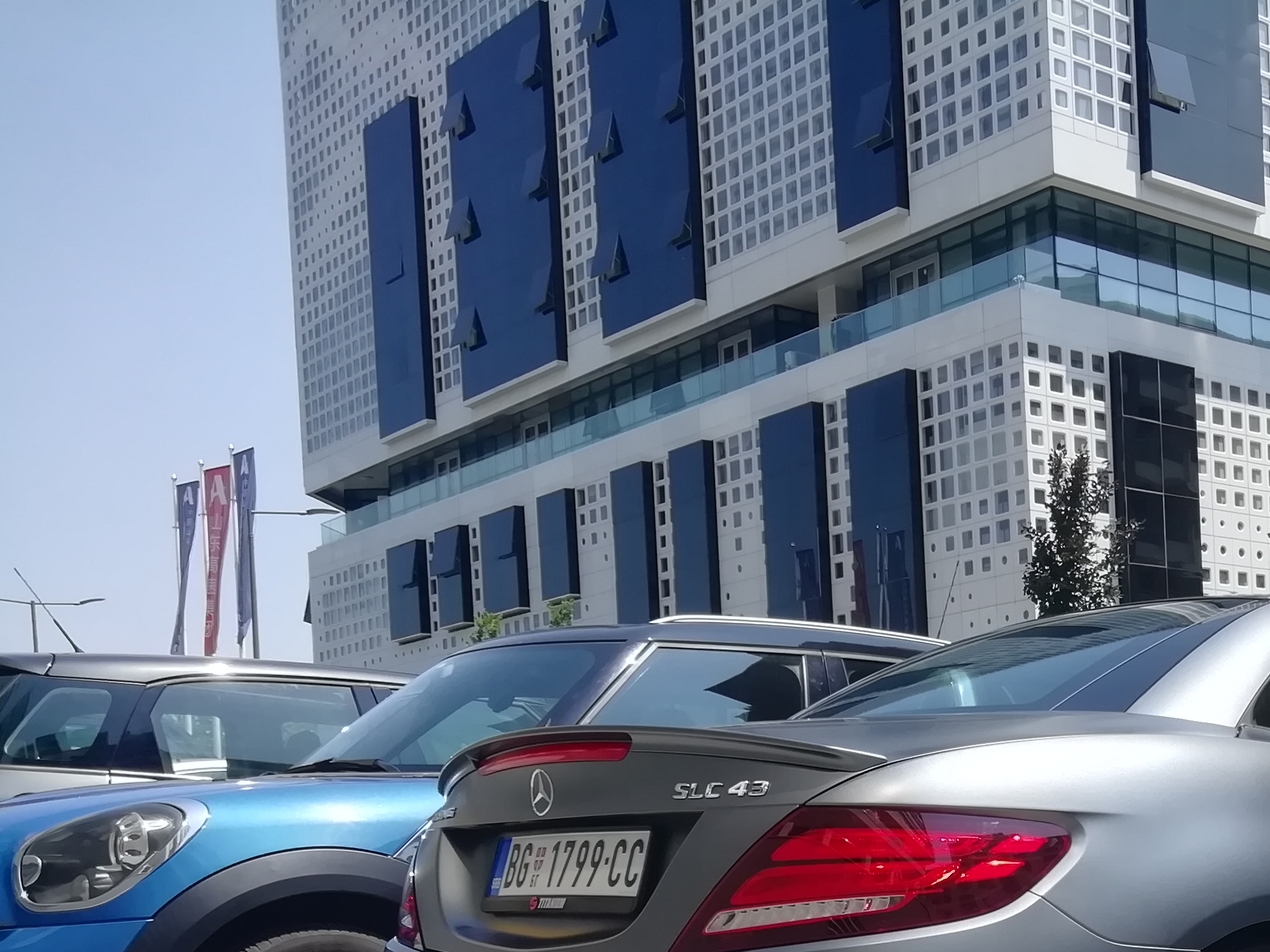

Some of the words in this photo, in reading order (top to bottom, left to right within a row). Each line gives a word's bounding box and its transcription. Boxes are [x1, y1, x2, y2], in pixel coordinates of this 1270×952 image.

[672, 782, 724, 801] SLC
[727, 779, 772, 798] 43
[503, 842, 533, 889] BG
